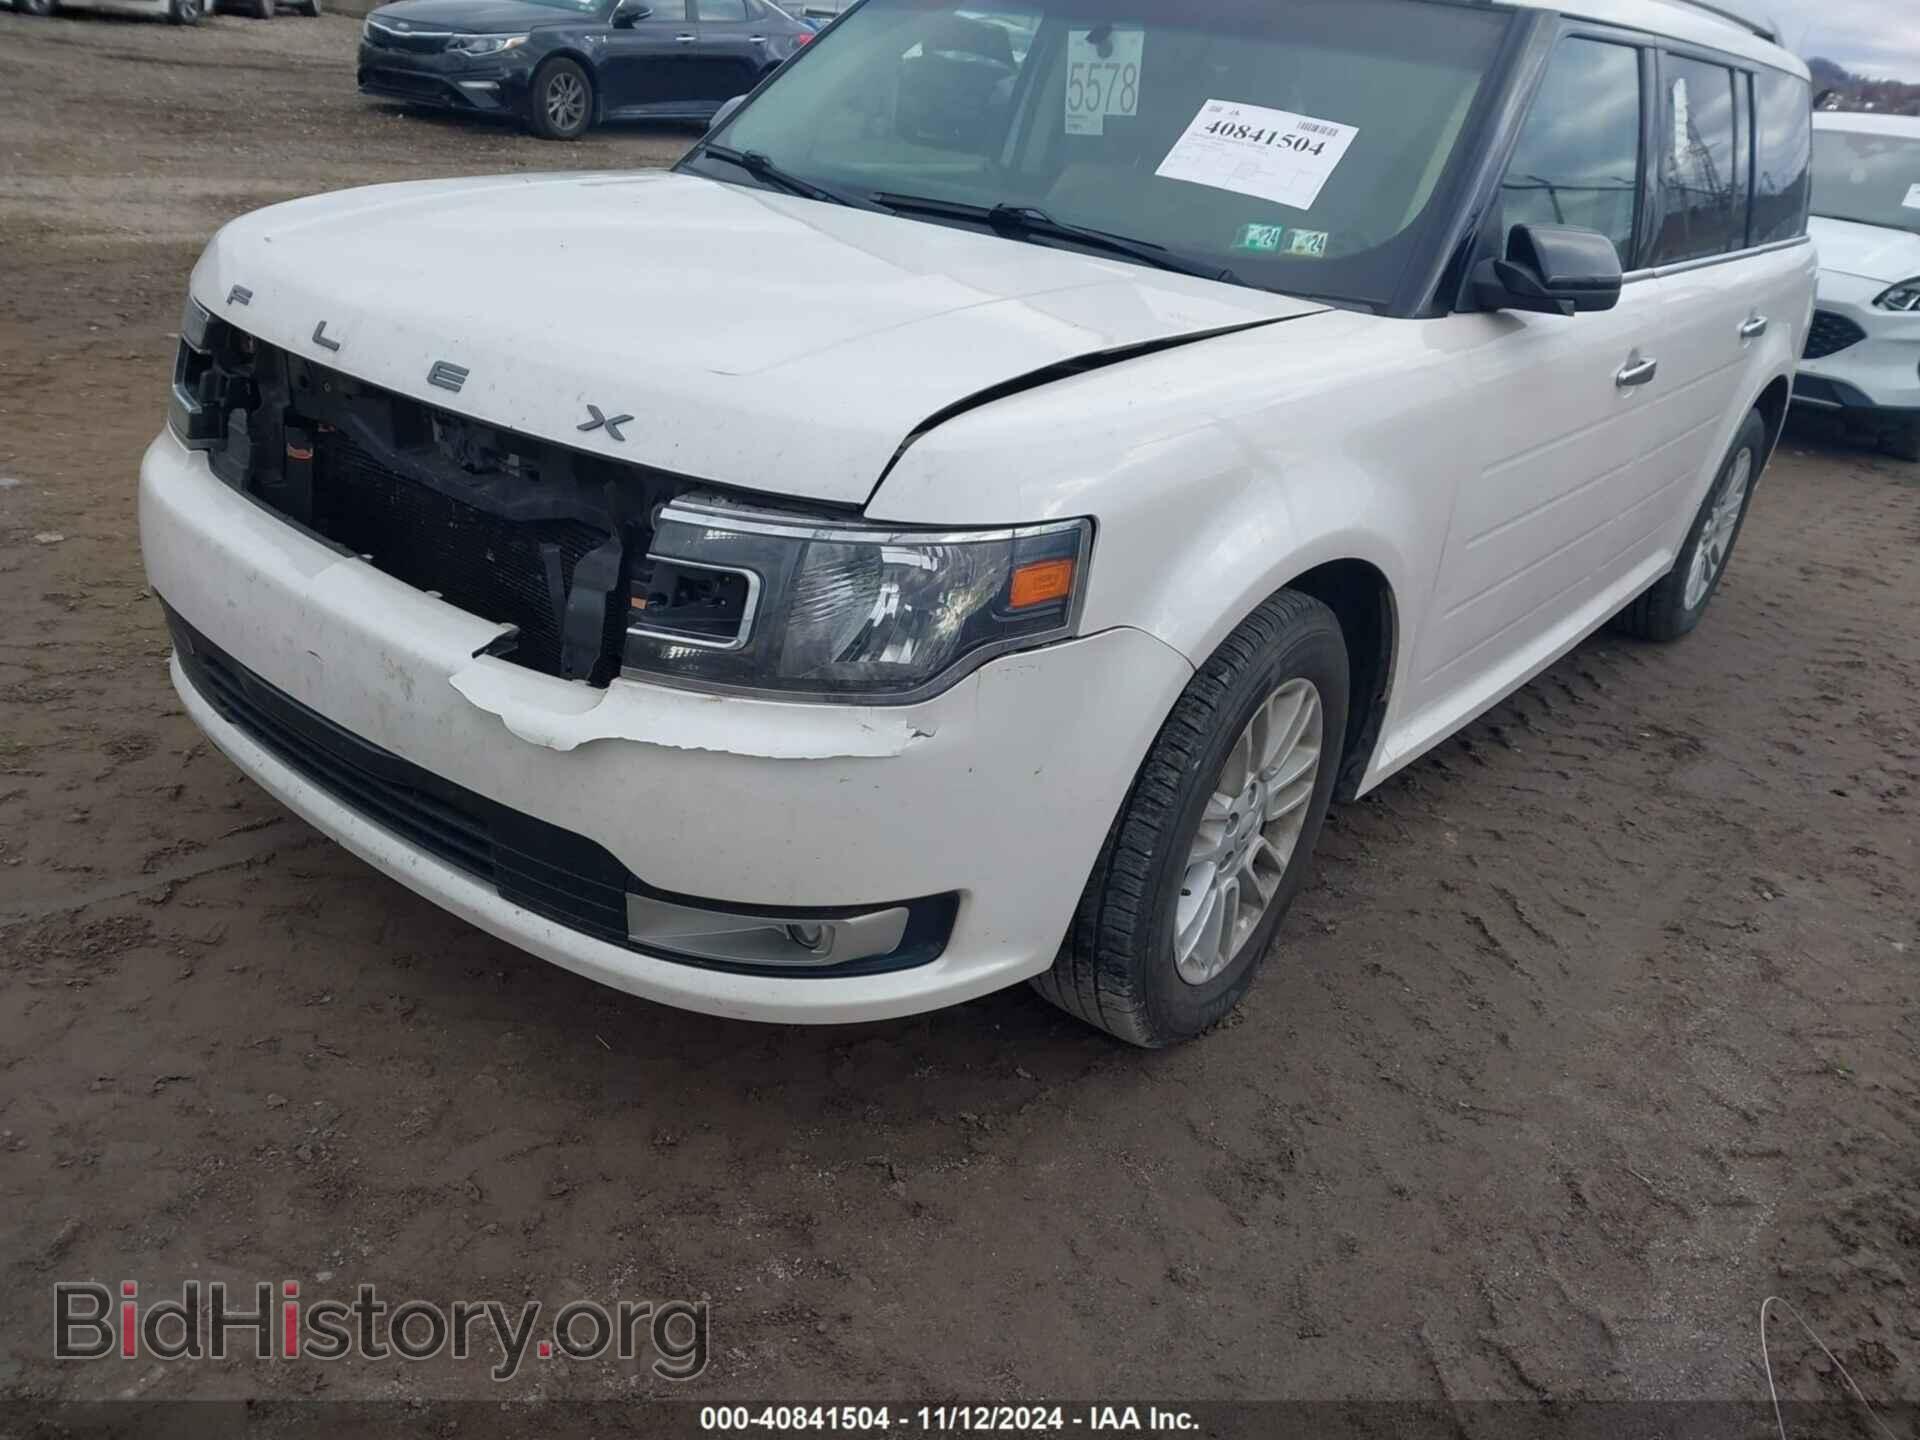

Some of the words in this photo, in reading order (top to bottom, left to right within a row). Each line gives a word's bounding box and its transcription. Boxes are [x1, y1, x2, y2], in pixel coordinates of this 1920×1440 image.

[1067, 62, 1137, 113] 5578
[1204, 119, 1327, 157] 40841504
[226, 283, 635, 442] FLEX
